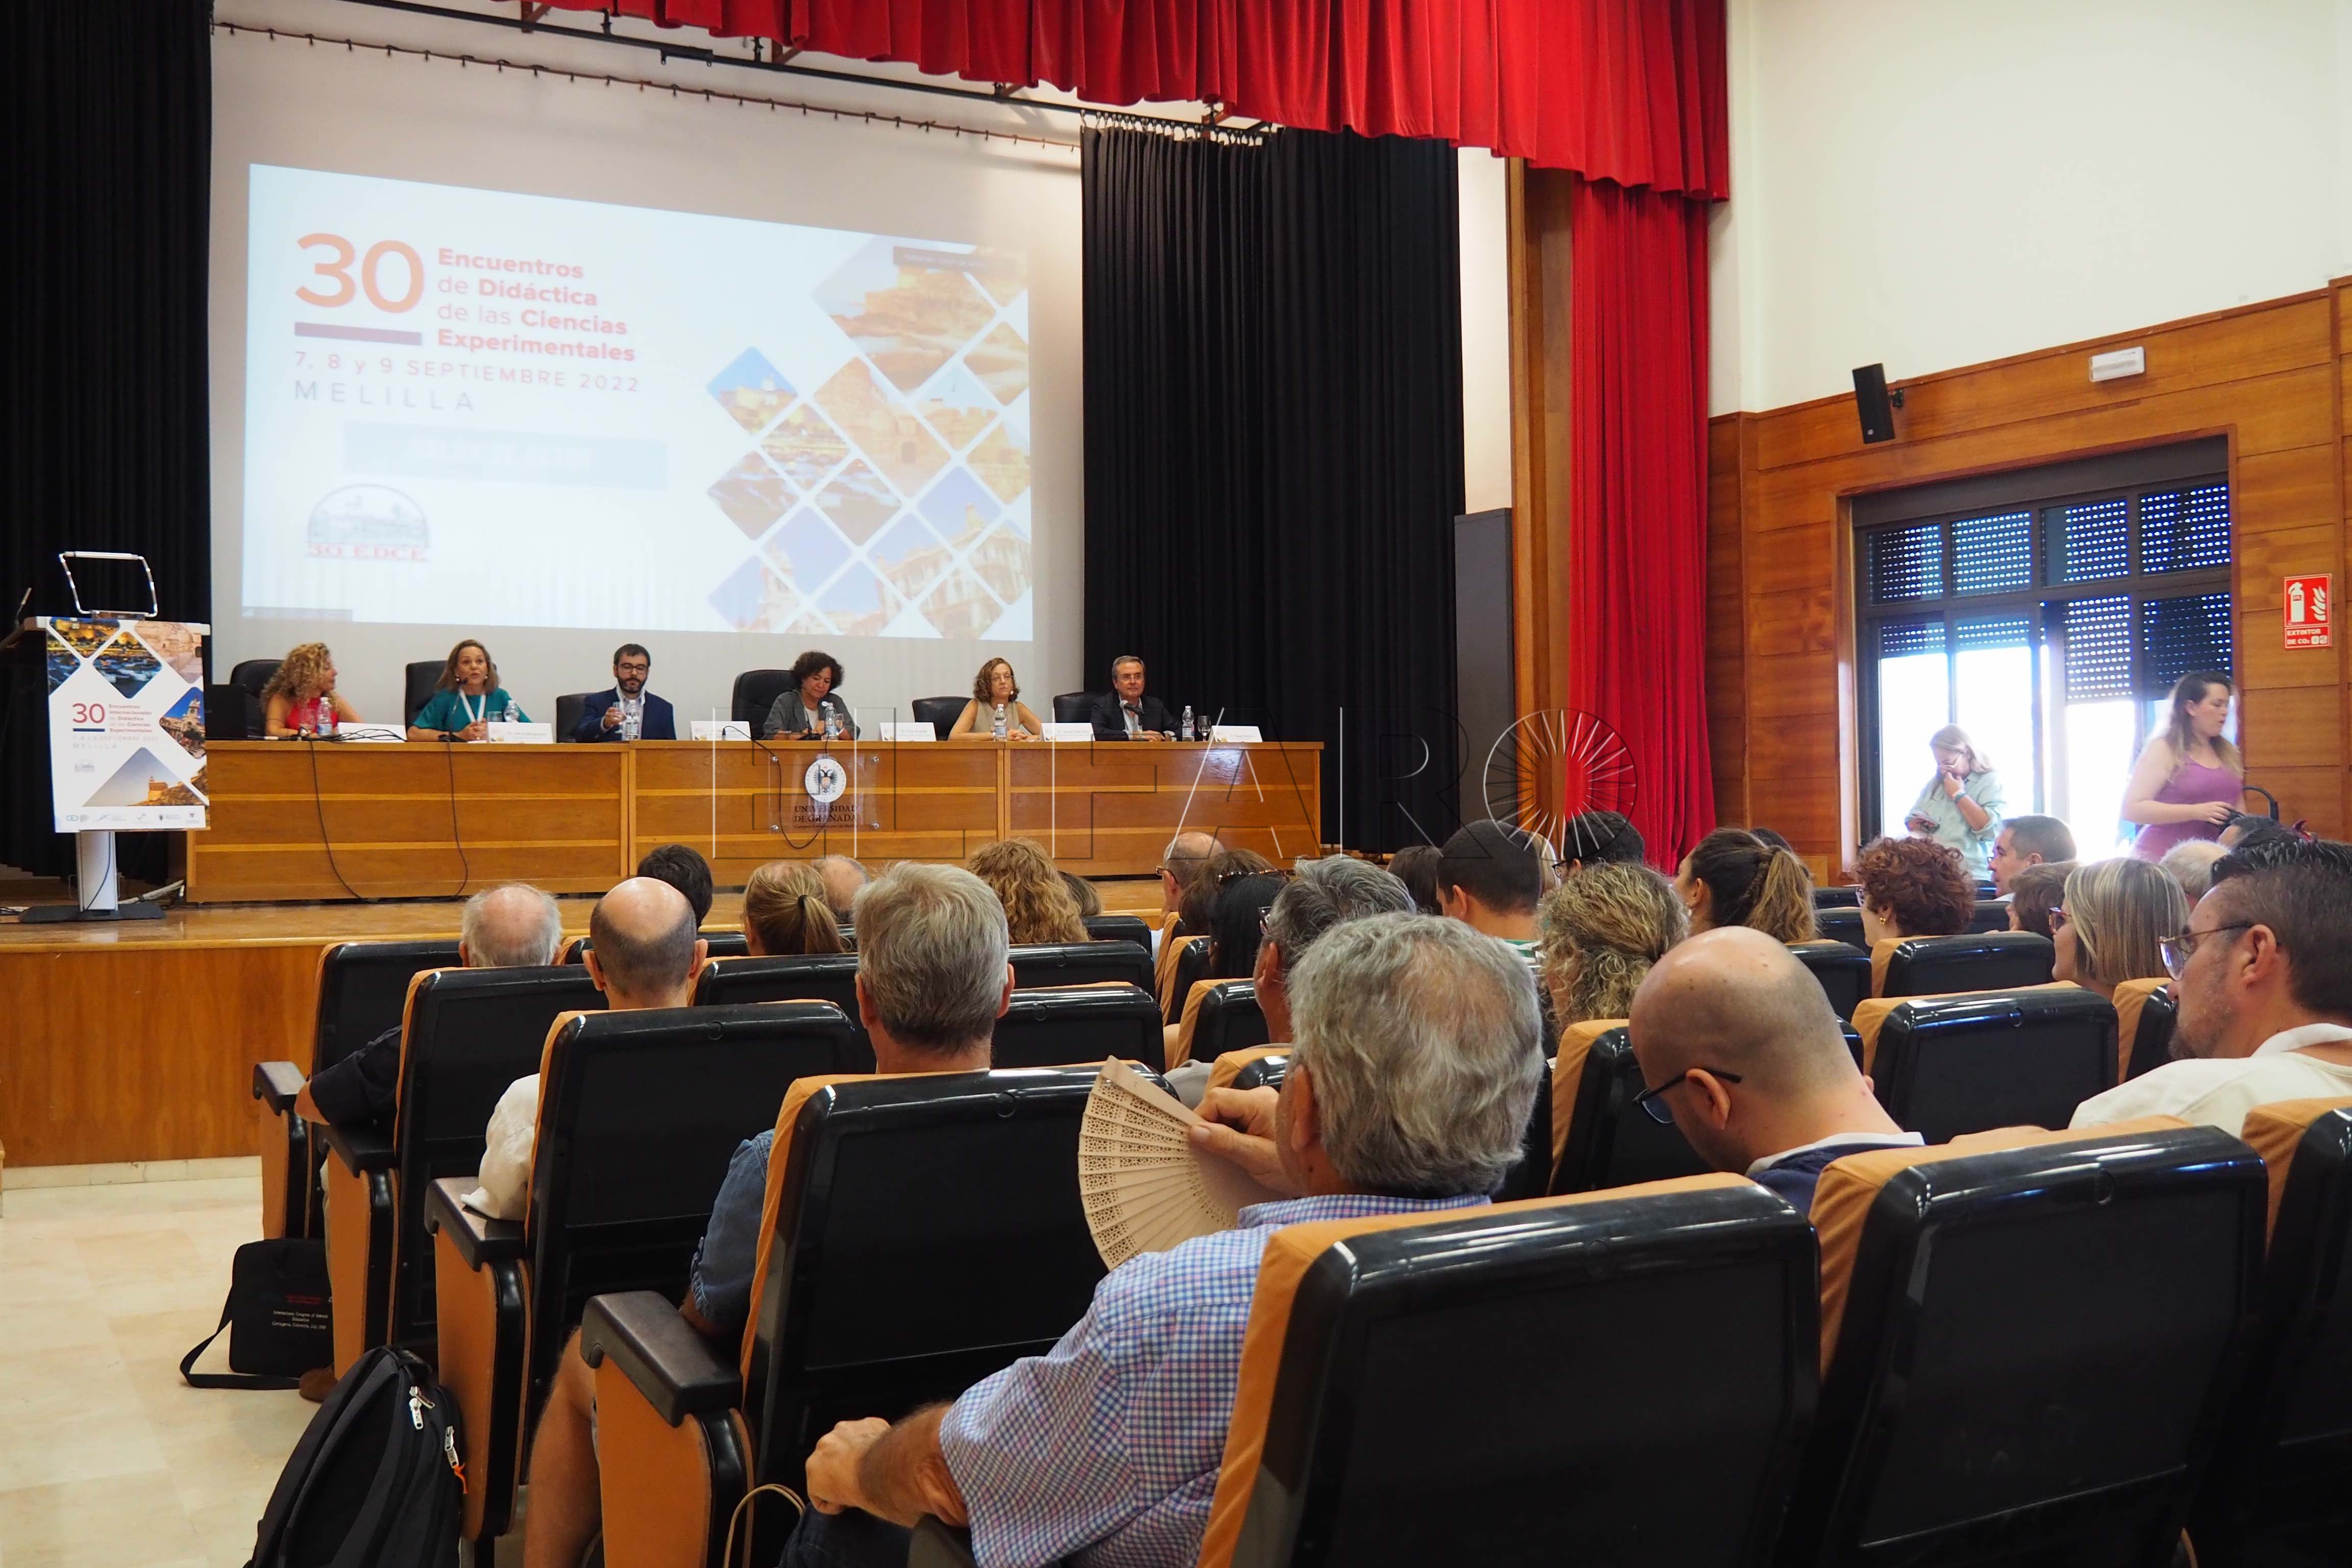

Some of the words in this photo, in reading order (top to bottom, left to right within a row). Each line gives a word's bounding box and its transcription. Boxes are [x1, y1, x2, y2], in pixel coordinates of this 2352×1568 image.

[295, 233, 425, 313] 30
[438, 248, 584, 279] Encuentros
[437, 276, 469, 295] de
[478, 278, 598, 306] Didáctica
[437, 303, 469, 321] de
[478, 305, 511, 325] las
[521, 309, 627, 335] Ciencias
[437, 328, 636, 362] Experimentales
[328, 353, 340, 369] 8
[355, 359, 366, 375] y
[380, 358, 394, 373] 9
[407, 359, 566, 387] SEPTIEMBRE
[579, 374, 640, 393] 2022
[295, 379, 474, 410] MELILLA
[72, 703, 105, 723] 30
